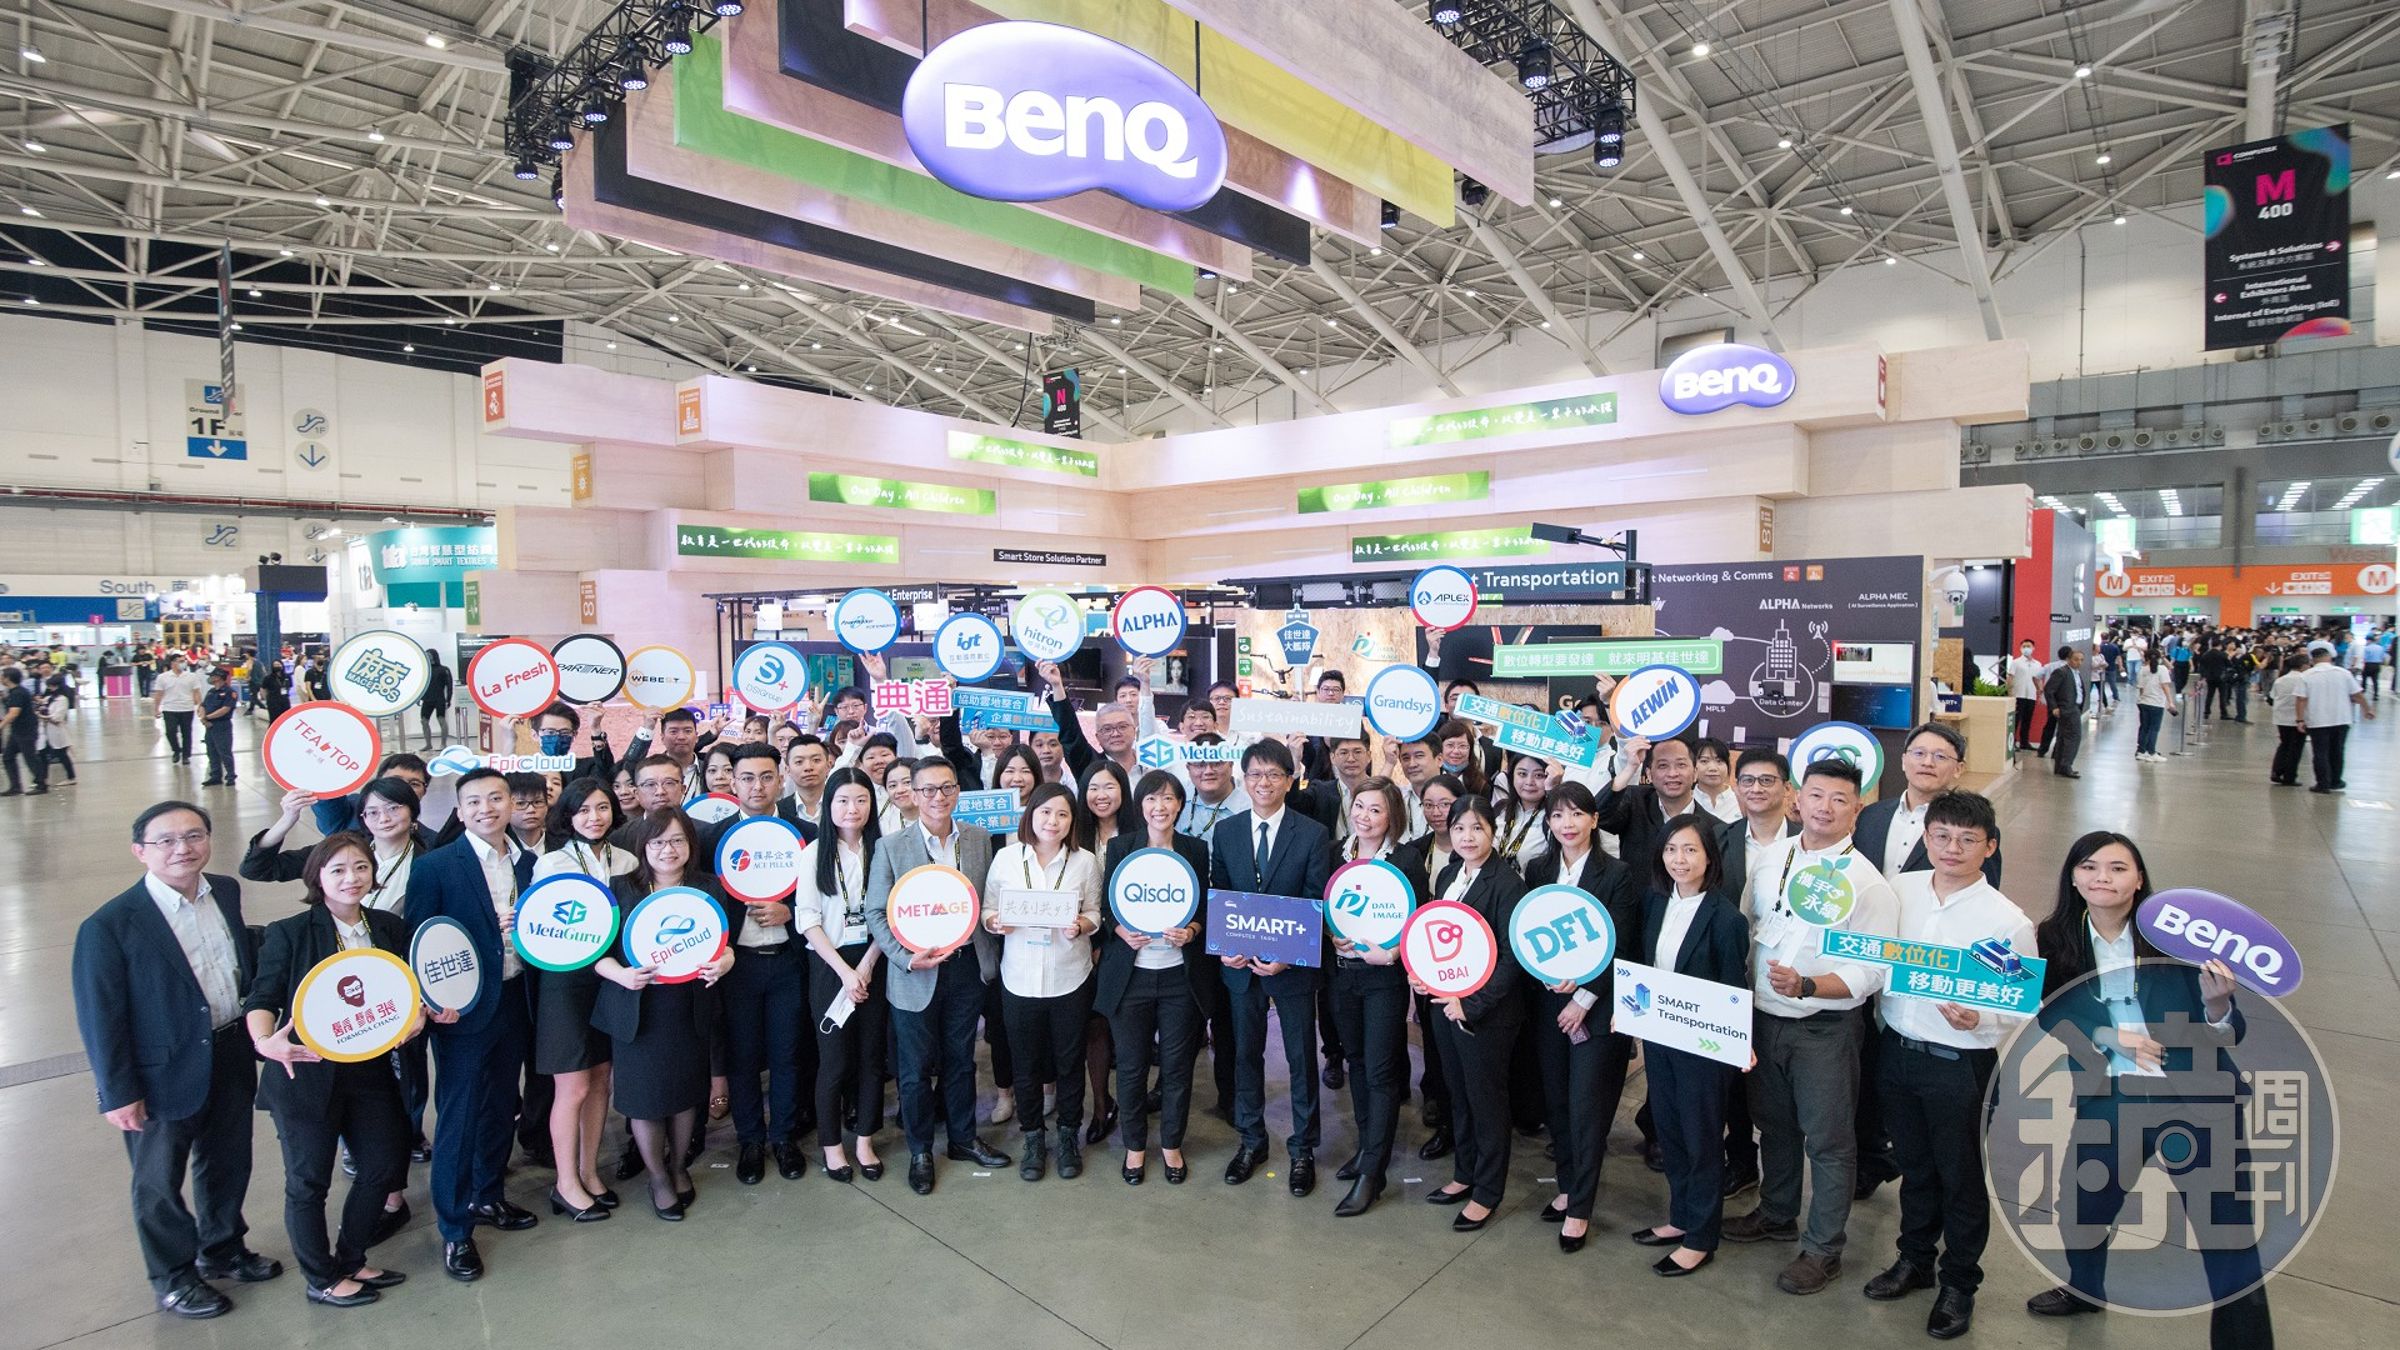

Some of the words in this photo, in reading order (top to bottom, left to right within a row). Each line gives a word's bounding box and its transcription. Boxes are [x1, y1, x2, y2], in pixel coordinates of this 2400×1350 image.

[944, 83, 1198, 179] BenQ
[2256, 169, 2295, 206] M
[2258, 202, 2294, 219] 400
[2229, 251, 2267, 263] Systems
[2277, 242, 2324, 254] Solutions
[2240, 287, 2288, 299] Exhibitors
[2289, 284, 2312, 292] Area
[2245, 275, 2307, 290] International
[2214, 312, 2251, 321] Internet
[2264, 304, 2315, 315] Everything
[1674, 363, 1782, 400] BenQ
[1056, 388, 1066, 405] N
[192, 417, 226, 436] 1F
[875, 487, 895, 503] Day
[905, 489, 920, 499] All
[1354, 491, 1374, 504] Day
[1384, 488, 1399, 498] All
[1403, 485, 1451, 498] Children
[433, 557, 453, 566] SMART
[998, 551, 1022, 561] Smart
[1023, 552, 1044, 562] Store
[1046, 553, 1076, 563] Solution
[1076, 555, 1102, 564] Partner
[1484, 569, 1619, 591] Transportation
[1658, 571, 1718, 584] Networking
[1721, 570, 1731, 582] &
[1733, 570, 1773, 581] Comms
[2106, 575, 2124, 590] M
[2139, 574, 2163, 583] EXIT
[2290, 572, 2316, 581] EXIT
[2368, 570, 2387, 586] M
[100, 580, 155, 594] South
[892, 588, 933, 603] Enterprise
[1859, 592, 1887, 601] ALPHA
[1889, 592, 1908, 600] MEC
[1433, 593, 1470, 602] APLEX
[1759, 598, 1800, 610] ALPHA
[1122, 611, 1178, 633] ALPHA
[1024, 626, 1063, 650] hitron
[1284, 630, 1311, 640] 佳世達
[556, 663, 620, 676] PARTNER
[1503, 653, 1595, 668] 數位轉型要發達
[481, 681, 501, 698] La
[504, 662, 548, 689] Fresh
[875, 680, 952, 717] 典通
[1374, 694, 1432, 715] Grandsys
[1630, 676, 1680, 729] AEWIN
[1759, 699, 1775, 707] Data
[1776, 699, 1804, 707] Cnter
[1238, 707, 1355, 735] Sustainability
[1470, 698, 1541, 730] 交通數位化
[294, 719, 323, 747] TEA
[329, 746, 360, 772] TOP
[1511, 729, 1585, 760] 移動更美好
[955, 796, 1008, 812] 雲地整合
[753, 861, 767, 870] ACE
[769, 861, 794, 869] PILLAR
[1123, 882, 1186, 904] Qisda
[1372, 902, 1396, 910] DATA
[1372, 911, 1404, 920] IMAGE
[1801, 893, 1843, 922] 永續
[526, 922, 602, 945] MetaGuru
[1225, 913, 1307, 936] SMART+
[1523, 907, 1600, 964] DFI
[2153, 903, 2283, 985] BenQ
[1838, 934, 1950, 969] 交通數位化
[424, 949, 475, 985] 佳世達
[1438, 965, 1469, 982] D8AI
[1908, 970, 2024, 1006] 移動更美好
[1657, 994, 1701, 1013] SMART
[336, 1026, 374, 1045] FORMOSA
[373, 1014, 400, 1033] CHANG
[1657, 1008, 1747, 1041] Transportation
